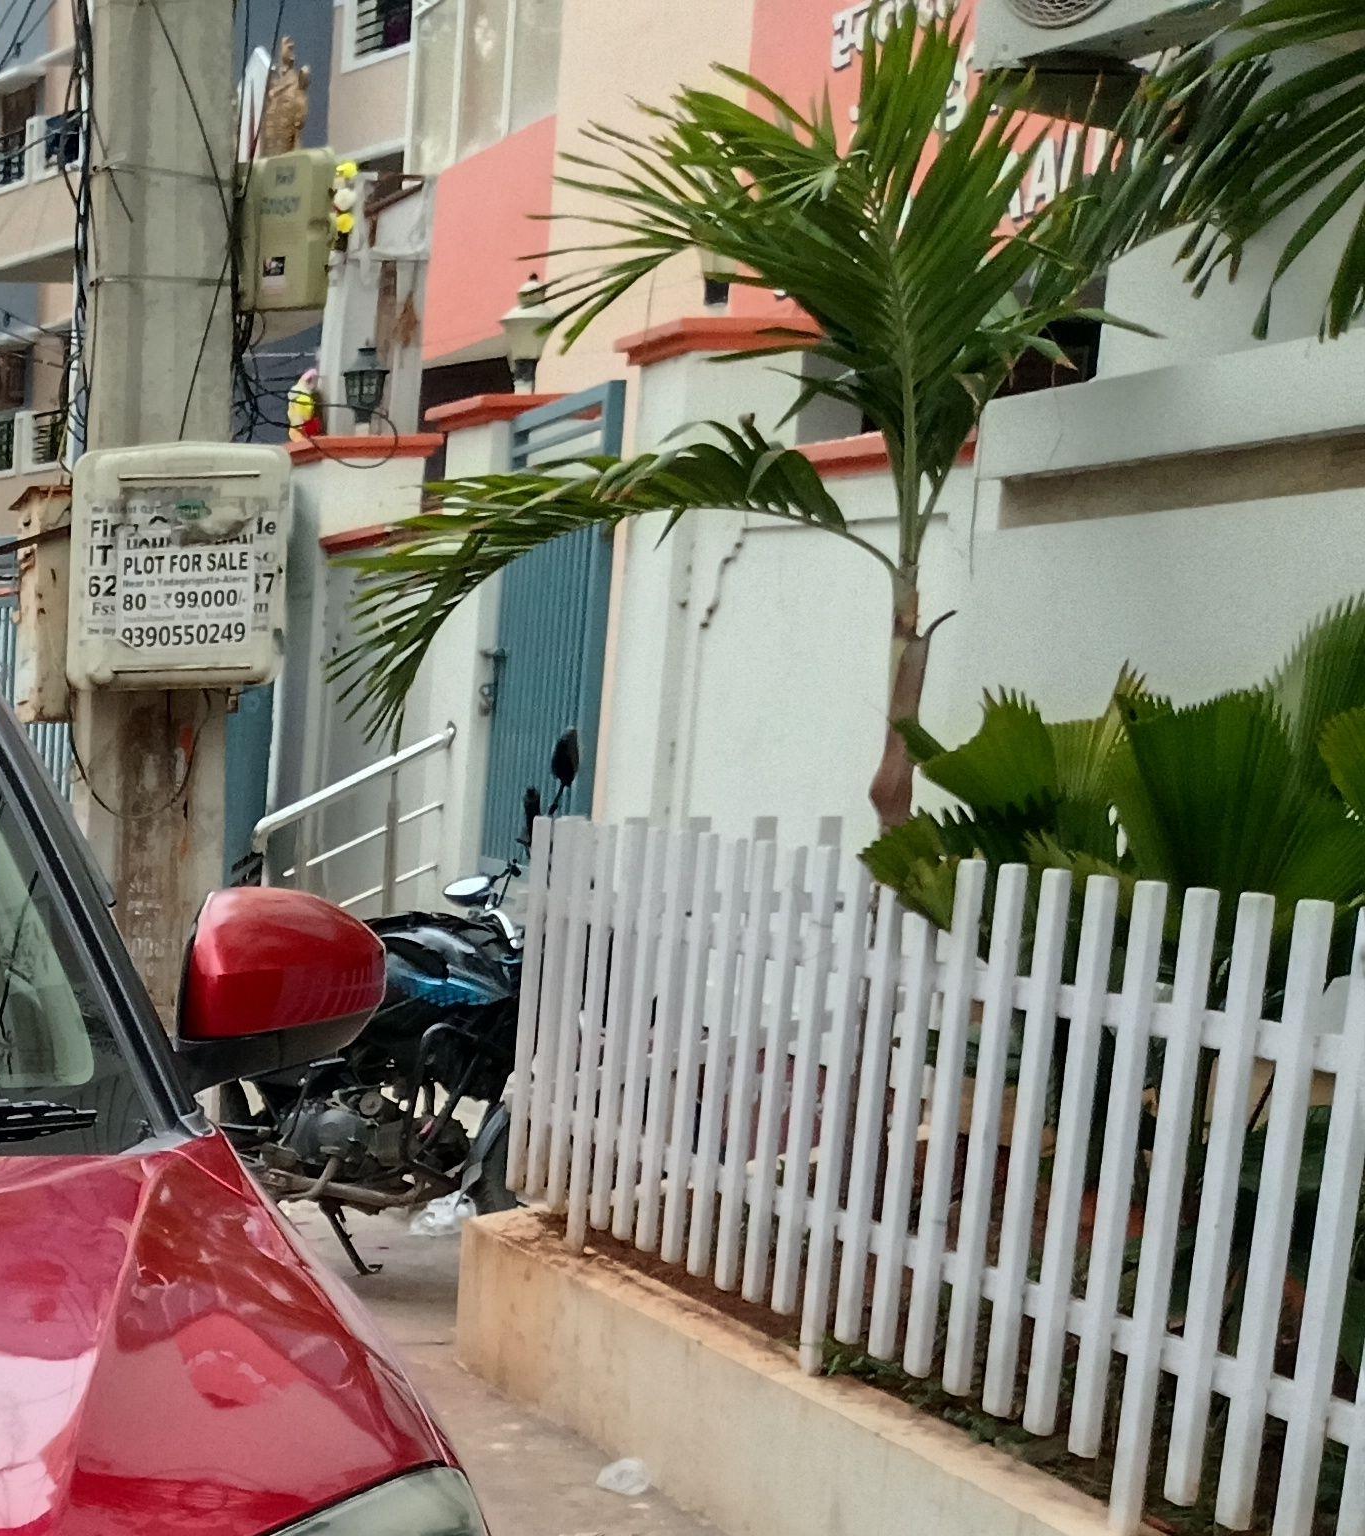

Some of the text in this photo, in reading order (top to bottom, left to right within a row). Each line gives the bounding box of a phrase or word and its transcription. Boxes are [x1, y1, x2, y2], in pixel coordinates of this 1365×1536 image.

[124, 555, 165, 576] PLOT
[170, 554, 202, 574] FOR
[207, 552, 249, 572] SALE
[123, 593, 147, 612] 80
[122, 622, 246, 648] 9390550249
